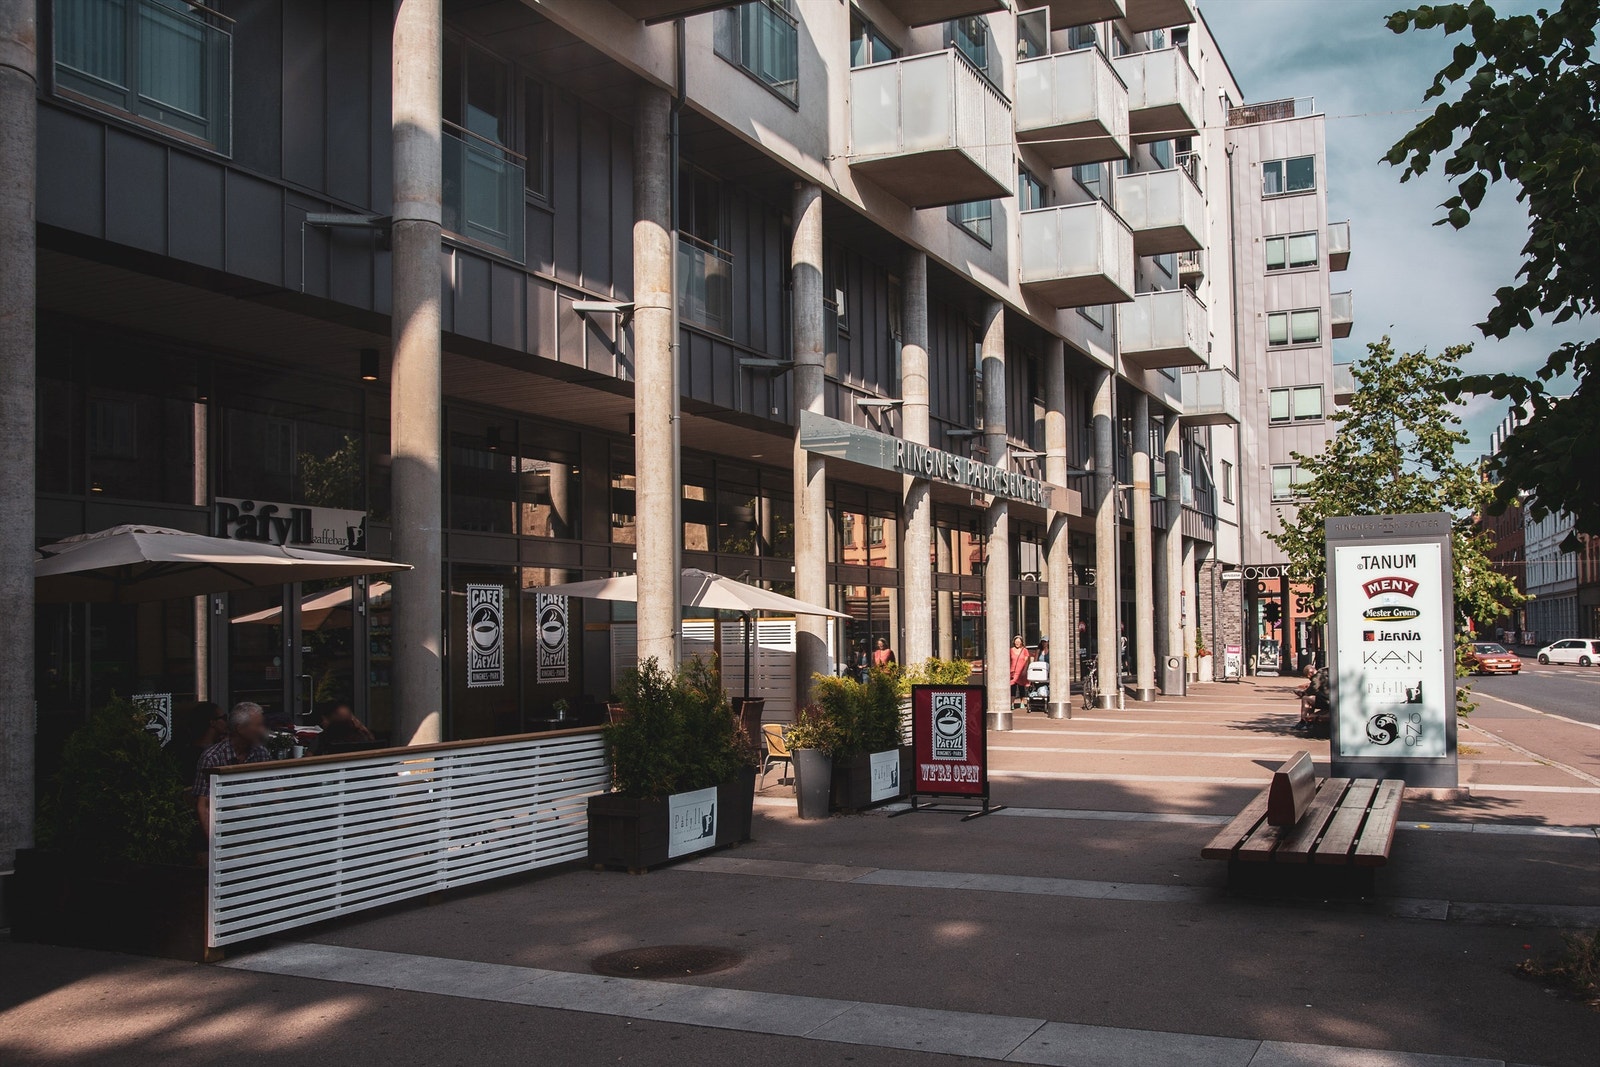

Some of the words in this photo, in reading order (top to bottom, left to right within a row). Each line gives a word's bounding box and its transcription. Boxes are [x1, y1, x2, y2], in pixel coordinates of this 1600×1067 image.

[896, 440, 960, 482] RINGNES
[967, 461, 997, 490] PARK
[1003, 470, 1043, 503] SENTER
[215, 501, 312, 546] Påfyll
[1378, 521, 1399, 530] PARK
[1361, 553, 1416, 570] TANUM
[1367, 580, 1413, 595] MENY
[472, 590, 499, 609] CAFE
[540, 593, 564, 609] CAFE
[1366, 608, 1391, 617] Mester
[1393, 608, 1417, 617] Grønn
[1363, 650, 1422, 664] KAN
[936, 696, 962, 709] CAFE
[920, 764, 952, 782] WE'RE
[953, 764, 979, 783] OPEN
